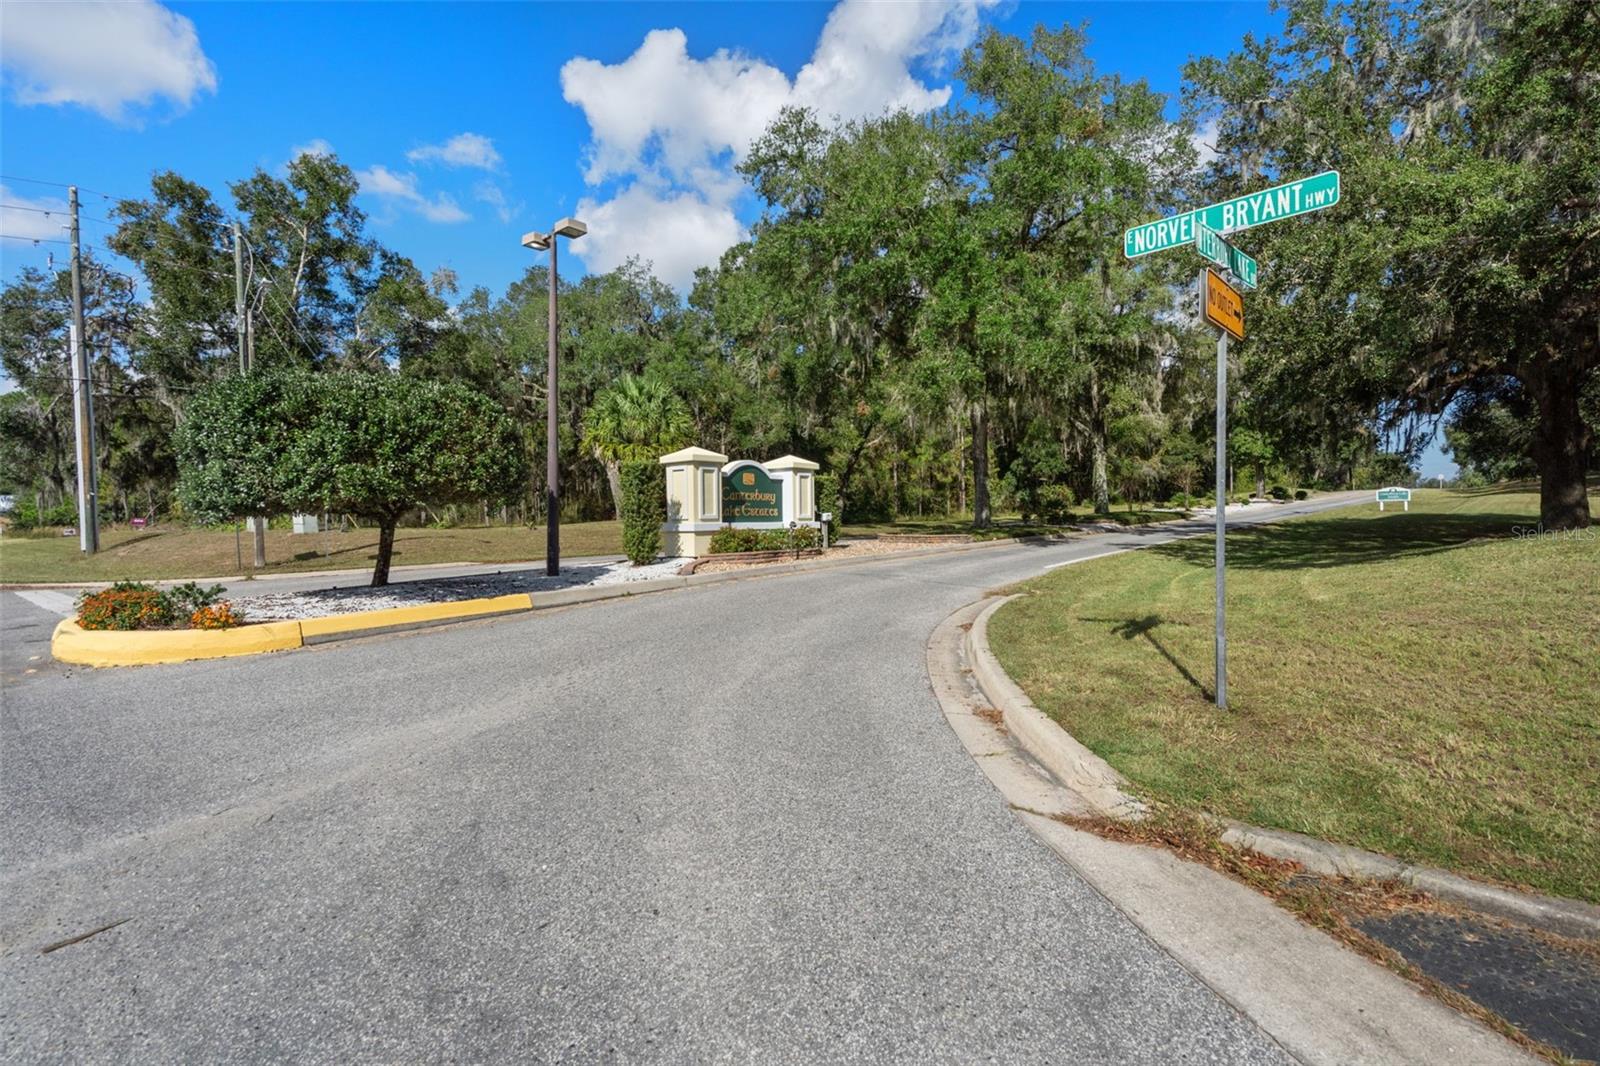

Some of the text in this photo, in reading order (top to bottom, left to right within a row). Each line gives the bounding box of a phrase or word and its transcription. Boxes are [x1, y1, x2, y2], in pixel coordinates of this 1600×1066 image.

[1127, 230, 1133, 244] E
[1223, 184, 1303, 230] BRYANT
[1306, 187, 1335, 208] HWY
[722, 504, 740, 517] ake
